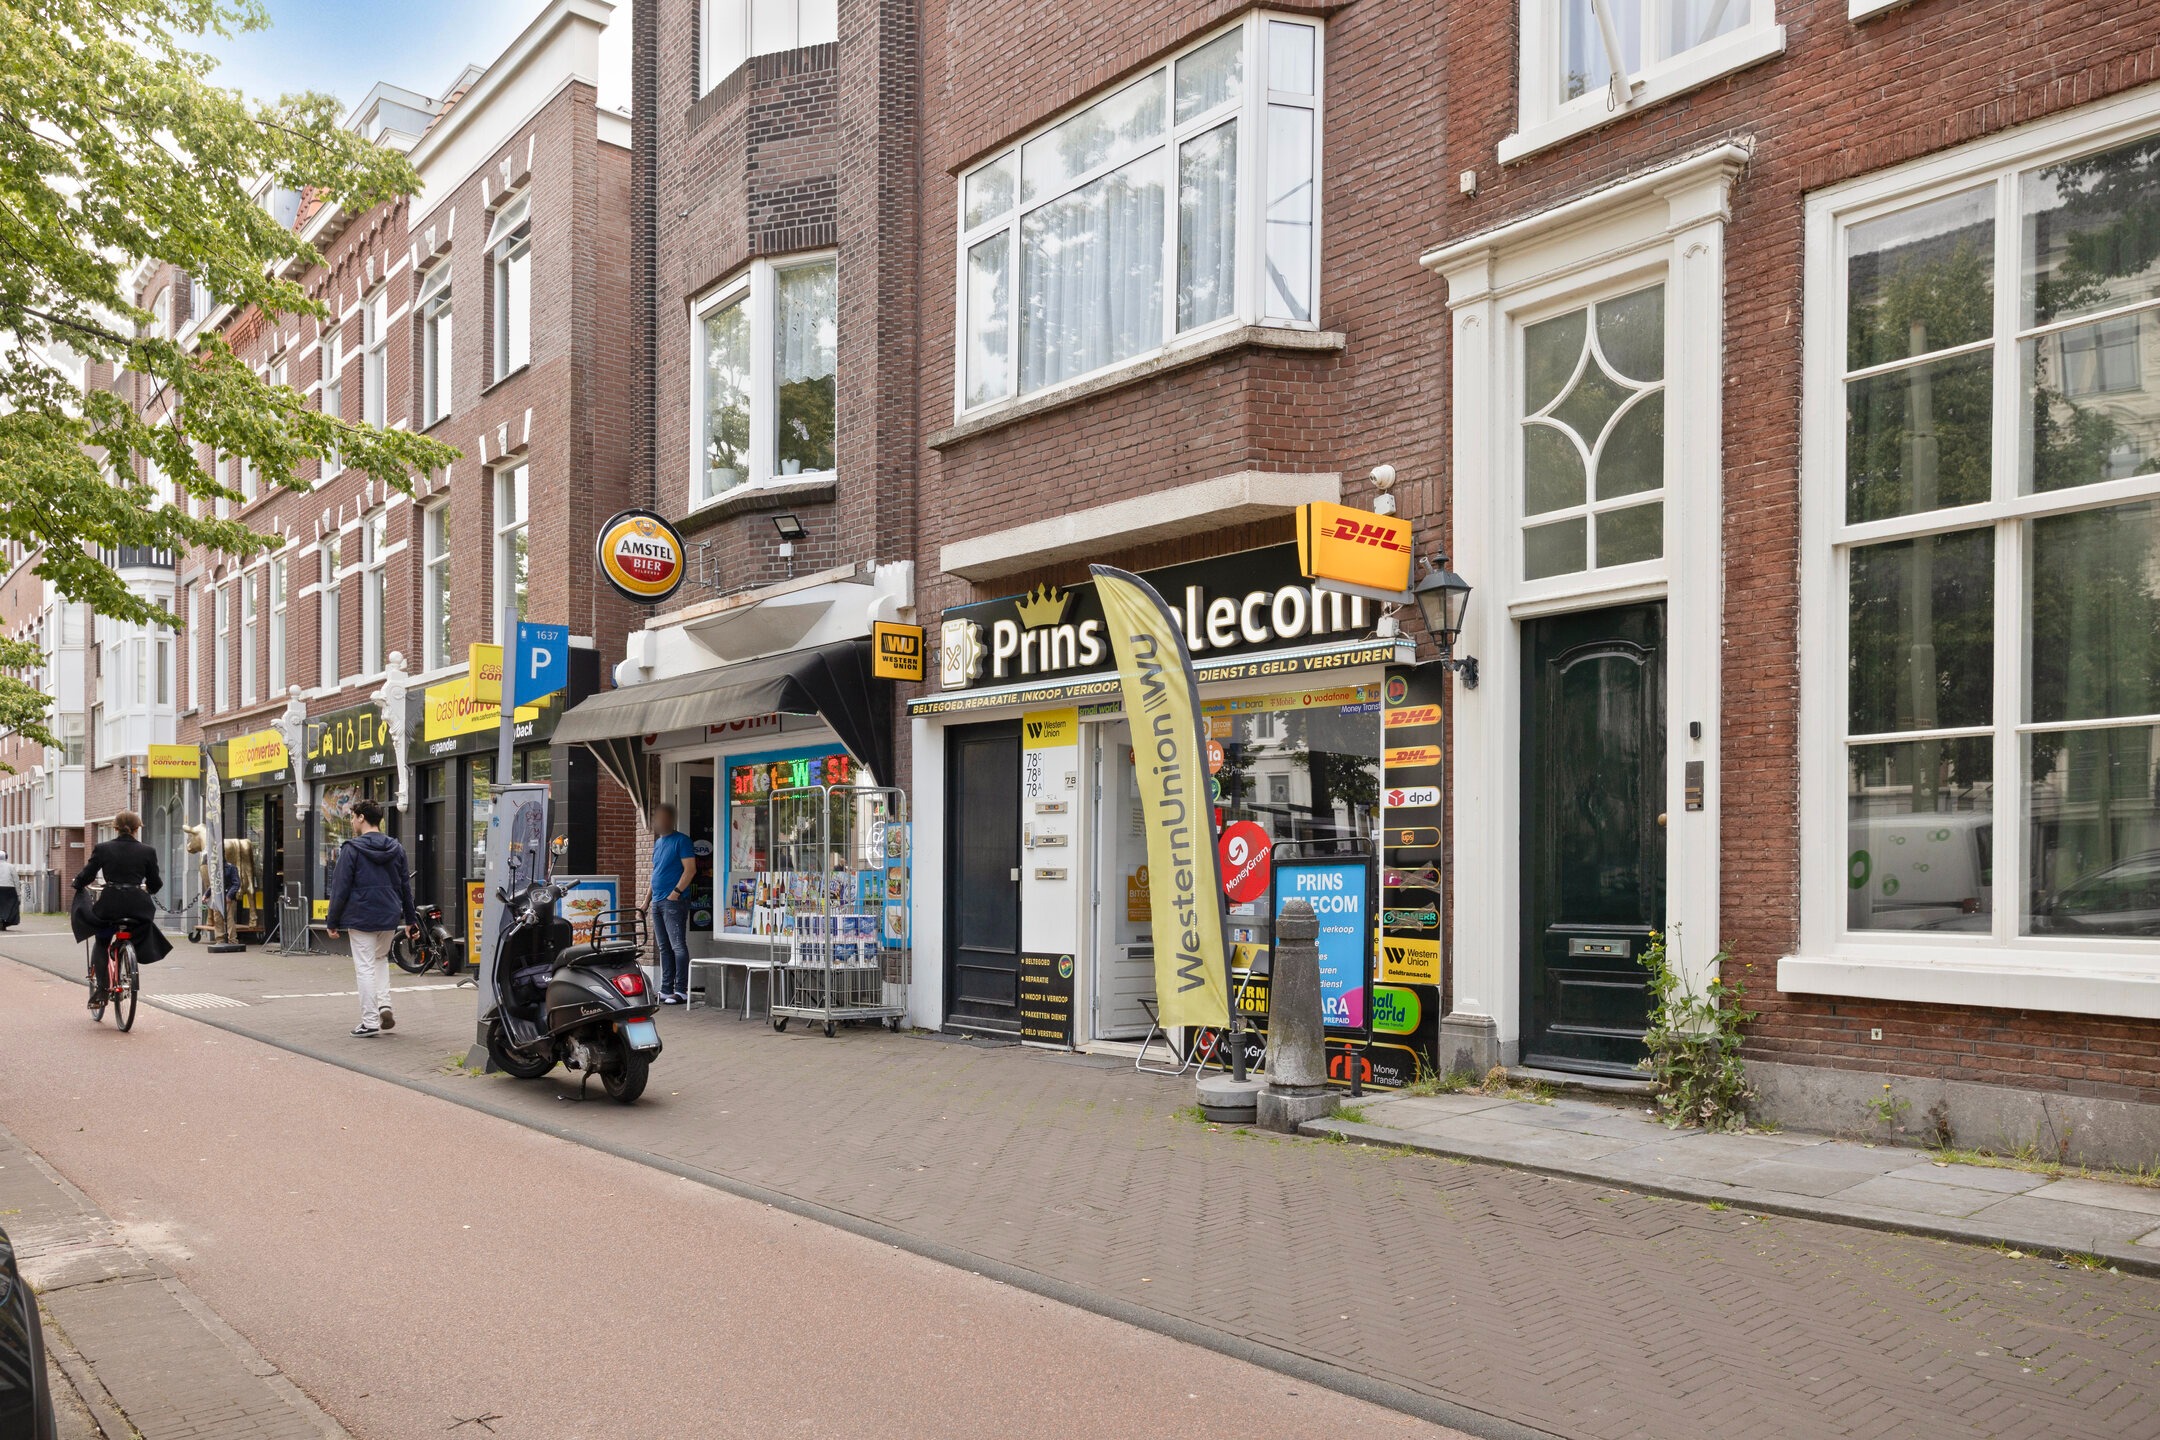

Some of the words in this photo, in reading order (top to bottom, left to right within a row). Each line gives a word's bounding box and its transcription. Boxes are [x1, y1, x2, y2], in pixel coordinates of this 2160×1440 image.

[1333, 517, 1401, 551] DHL
[621, 540, 673, 560] AMSTEL
[633, 558, 661, 572] BIER
[536, 631, 559, 640] 1637
[993, 618, 1099, 679] Prins
[1170, 584, 1370, 653] lecom
[531, 647, 551, 680] P
[882, 655, 918, 666] WESTERN
[1198, 665, 1245, 682] DIENST
[1248, 664, 1258, 677] &
[1261, 659, 1299, 675] GELD
[1303, 647, 1394, 671] VERSTUREN
[482, 663, 503, 674] cas
[893, 662, 918, 671] UNION
[1314, 693, 1350, 703] vodafone
[1079, 704, 1098, 716] small
[1099, 702, 1120, 714] world
[1341, 704, 1362, 714] Money
[1390, 709, 1436, 725] DHL
[1044, 720, 1067, 732] Western
[1043, 729, 1060, 738] Union
[1207, 744, 1221, 761] ia
[1396, 749, 1427, 761] DHL
[153, 759, 197, 767] converters
[1065, 776, 1077, 785] 78
[1409, 791, 1432, 805] dpd
[1296, 872, 1343, 891] PRINS
[1321, 926, 1355, 935] verkoop
[1406, 948, 1439, 959] Western
[1024, 958, 1051, 966] BELTEGOED
[1406, 956, 1429, 967] Union
[1024, 975, 1049, 984] REPARATIE
[1388, 969, 1432, 979] Geldtransactie
[1024, 993, 1042, 1001] INKOOP
[1047, 995, 1069, 1004] VERKOOP
[1024, 1010, 1051, 1020] PAKKETTEN
[1051, 1013, 1068, 1022] DIENST
[1037, 1029, 1064, 1039] VERSTUREN
[1373, 1063, 1399, 1078] Money
[1373, 1075, 1403, 1087] Transfer
